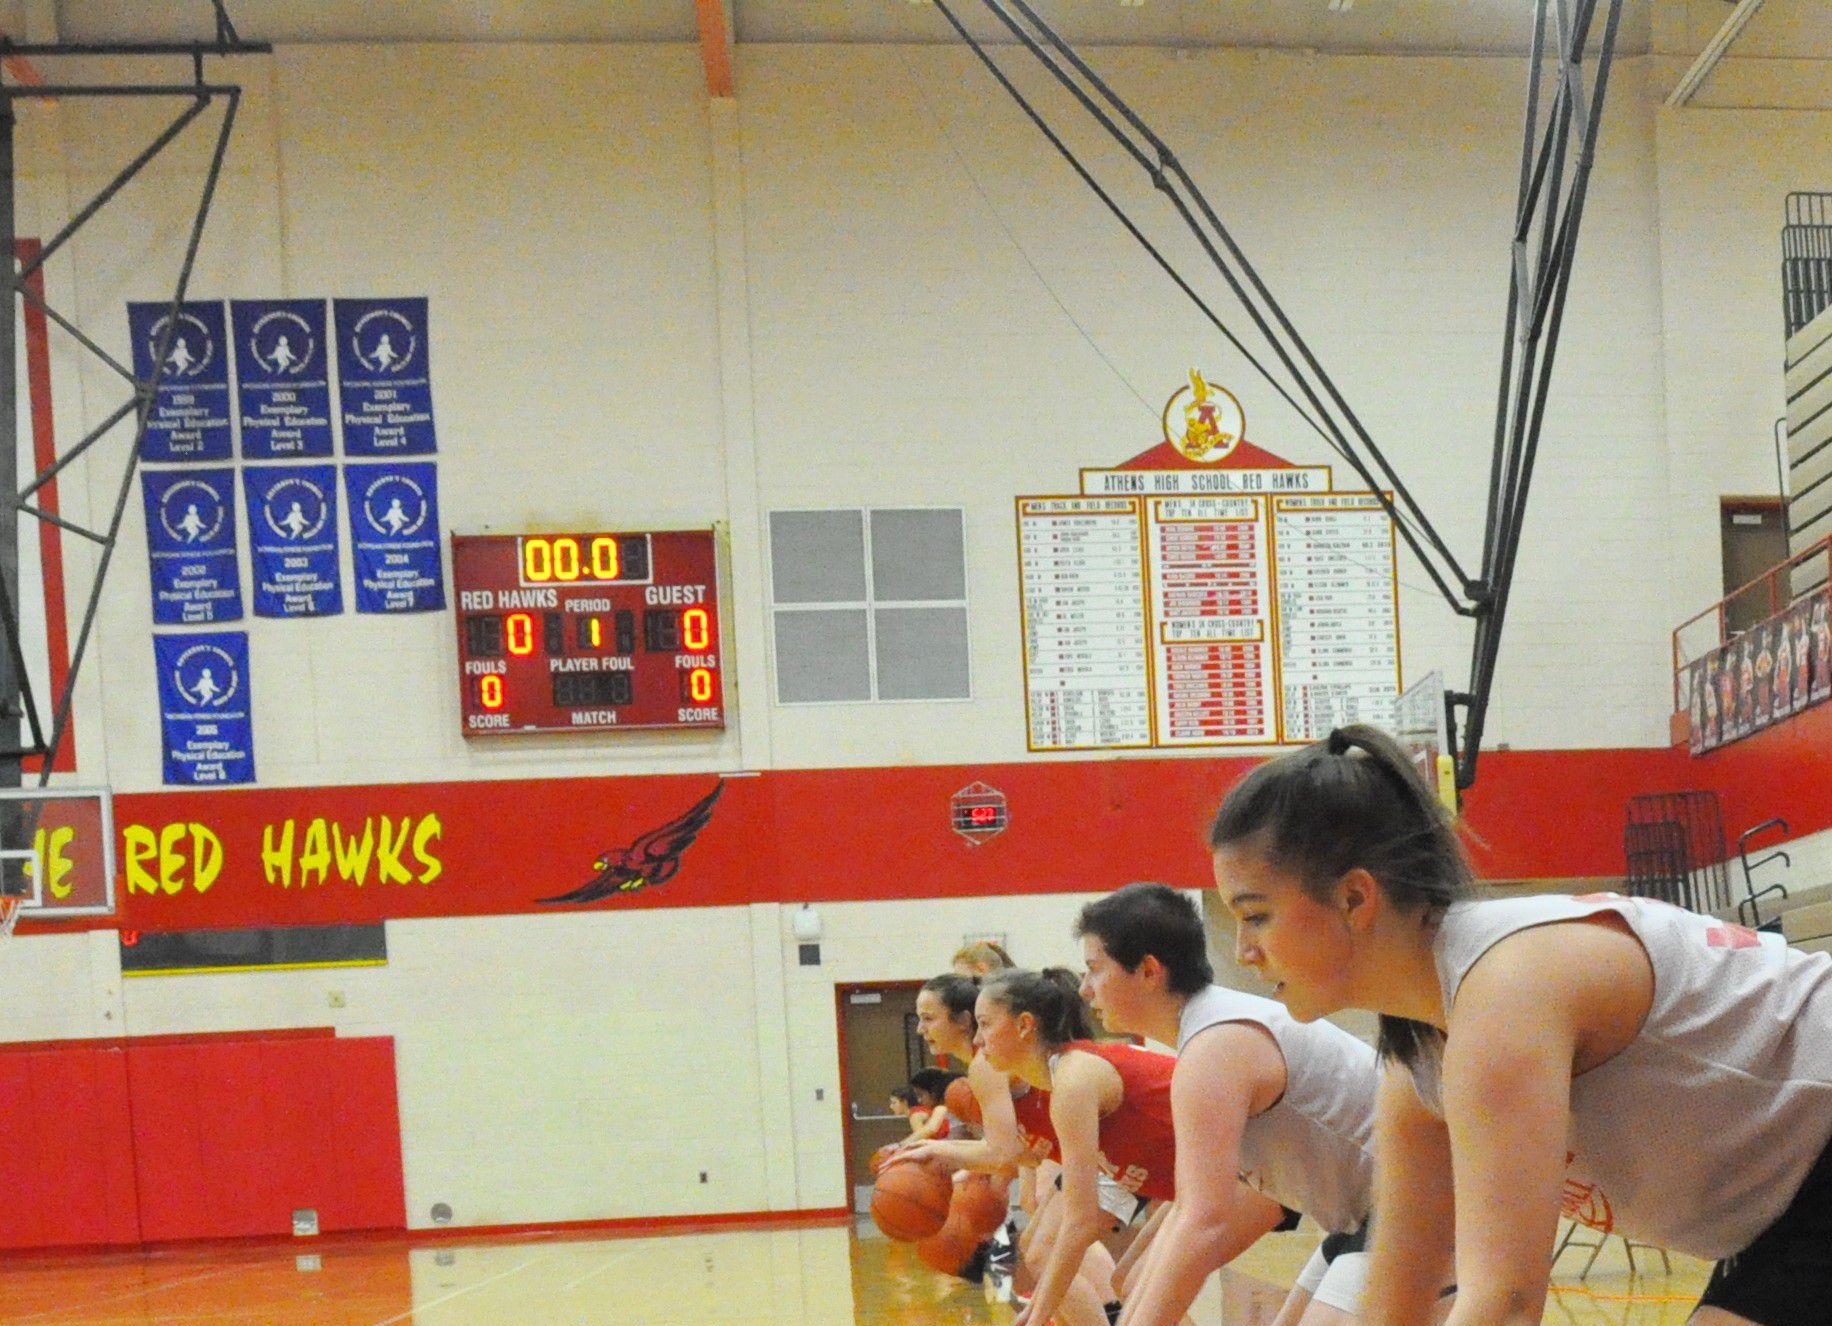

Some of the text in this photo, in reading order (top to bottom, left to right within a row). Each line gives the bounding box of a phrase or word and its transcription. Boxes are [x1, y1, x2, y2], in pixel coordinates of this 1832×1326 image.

[1104, 472, 1309, 491] ATHENS HIGH SCHOOL RED HAWKS
[526, 538, 618, 581] 00.0
[461, 589, 558, 610] RED HAWKS
[646, 585, 706, 605] GUEST
[565, 599, 611, 612] PERIOD
[506, 614, 533, 655] 0
[590, 618, 600, 647] 1
[684, 609, 709, 649] 0
[466, 660, 506, 674] FOULS
[550, 657, 634, 672] PLAYER FOUL
[675, 655, 716, 668] FOULS
[481, 675, 501, 708] 0
[691, 669, 711, 701] 0
[469, 714, 510, 728] SCORE
[572, 711, 616, 725] MATCH
[678, 708, 718, 722] SCORE
[123, 822, 223, 895] RED
[261, 813, 442, 888] HAWKS
